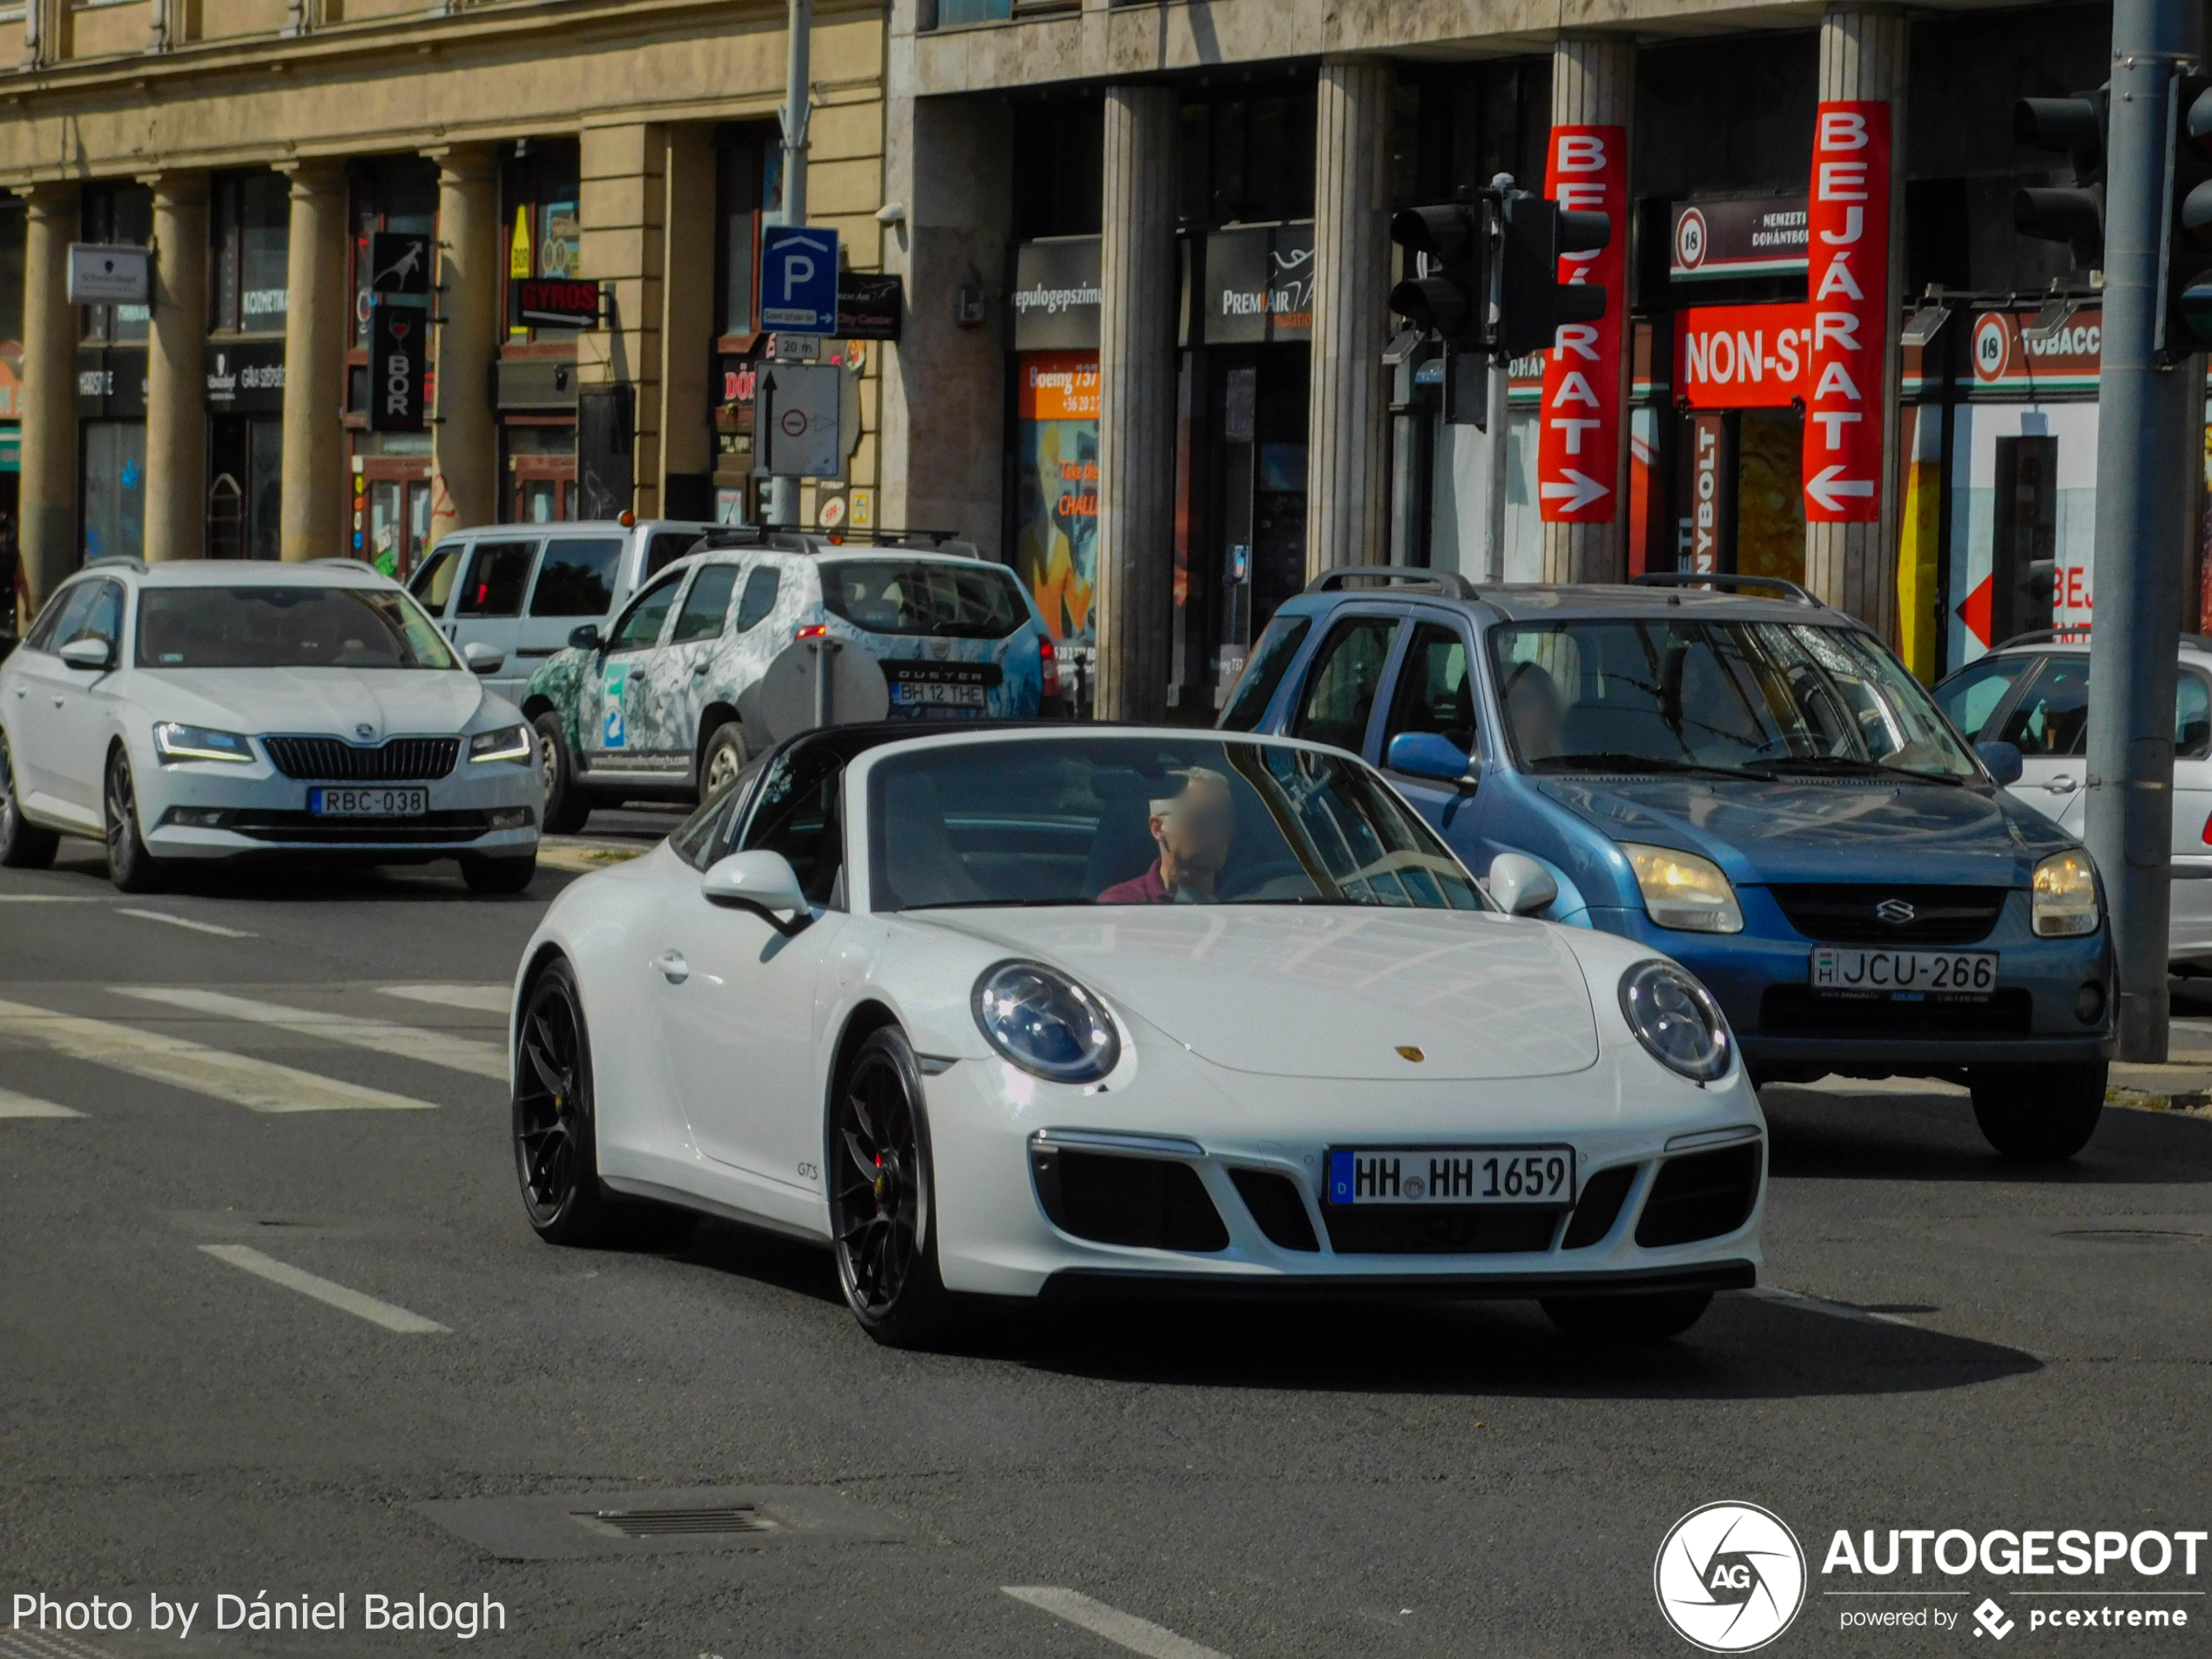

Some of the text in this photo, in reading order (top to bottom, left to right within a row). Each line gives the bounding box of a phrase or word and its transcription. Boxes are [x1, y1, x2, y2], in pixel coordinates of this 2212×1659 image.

[1763, 211, 1807, 227] NEMZETI
[1684, 231, 1698, 252] 18
[784, 254, 815, 301] P
[1812, 111, 1870, 450] BEJÁRAT
[523, 283, 597, 311] GYROS
[1550, 135, 1608, 455] BERAT
[784, 341, 813, 353] 20 m
[1981, 336, 1999, 360] 18
[387, 354, 410, 416] BOR
[1029, 362, 1099, 395] Boeing 737
[1062, 396, 1077, 412] +36
[1079, 395, 1089, 411] 20
[1060, 459, 1099, 481] Take the
[1697, 426, 1716, 591] NYBOLT
[899, 670, 982, 680] DUSTER
[901, 684, 981, 703] BH 12 THE
[327, 792, 421, 812] RBC-038
[1819, 954, 1992, 988] H JCU-266
[798, 1162, 818, 1180] GTS
[1337, 1157, 1565, 1197] D HH HH 1659
